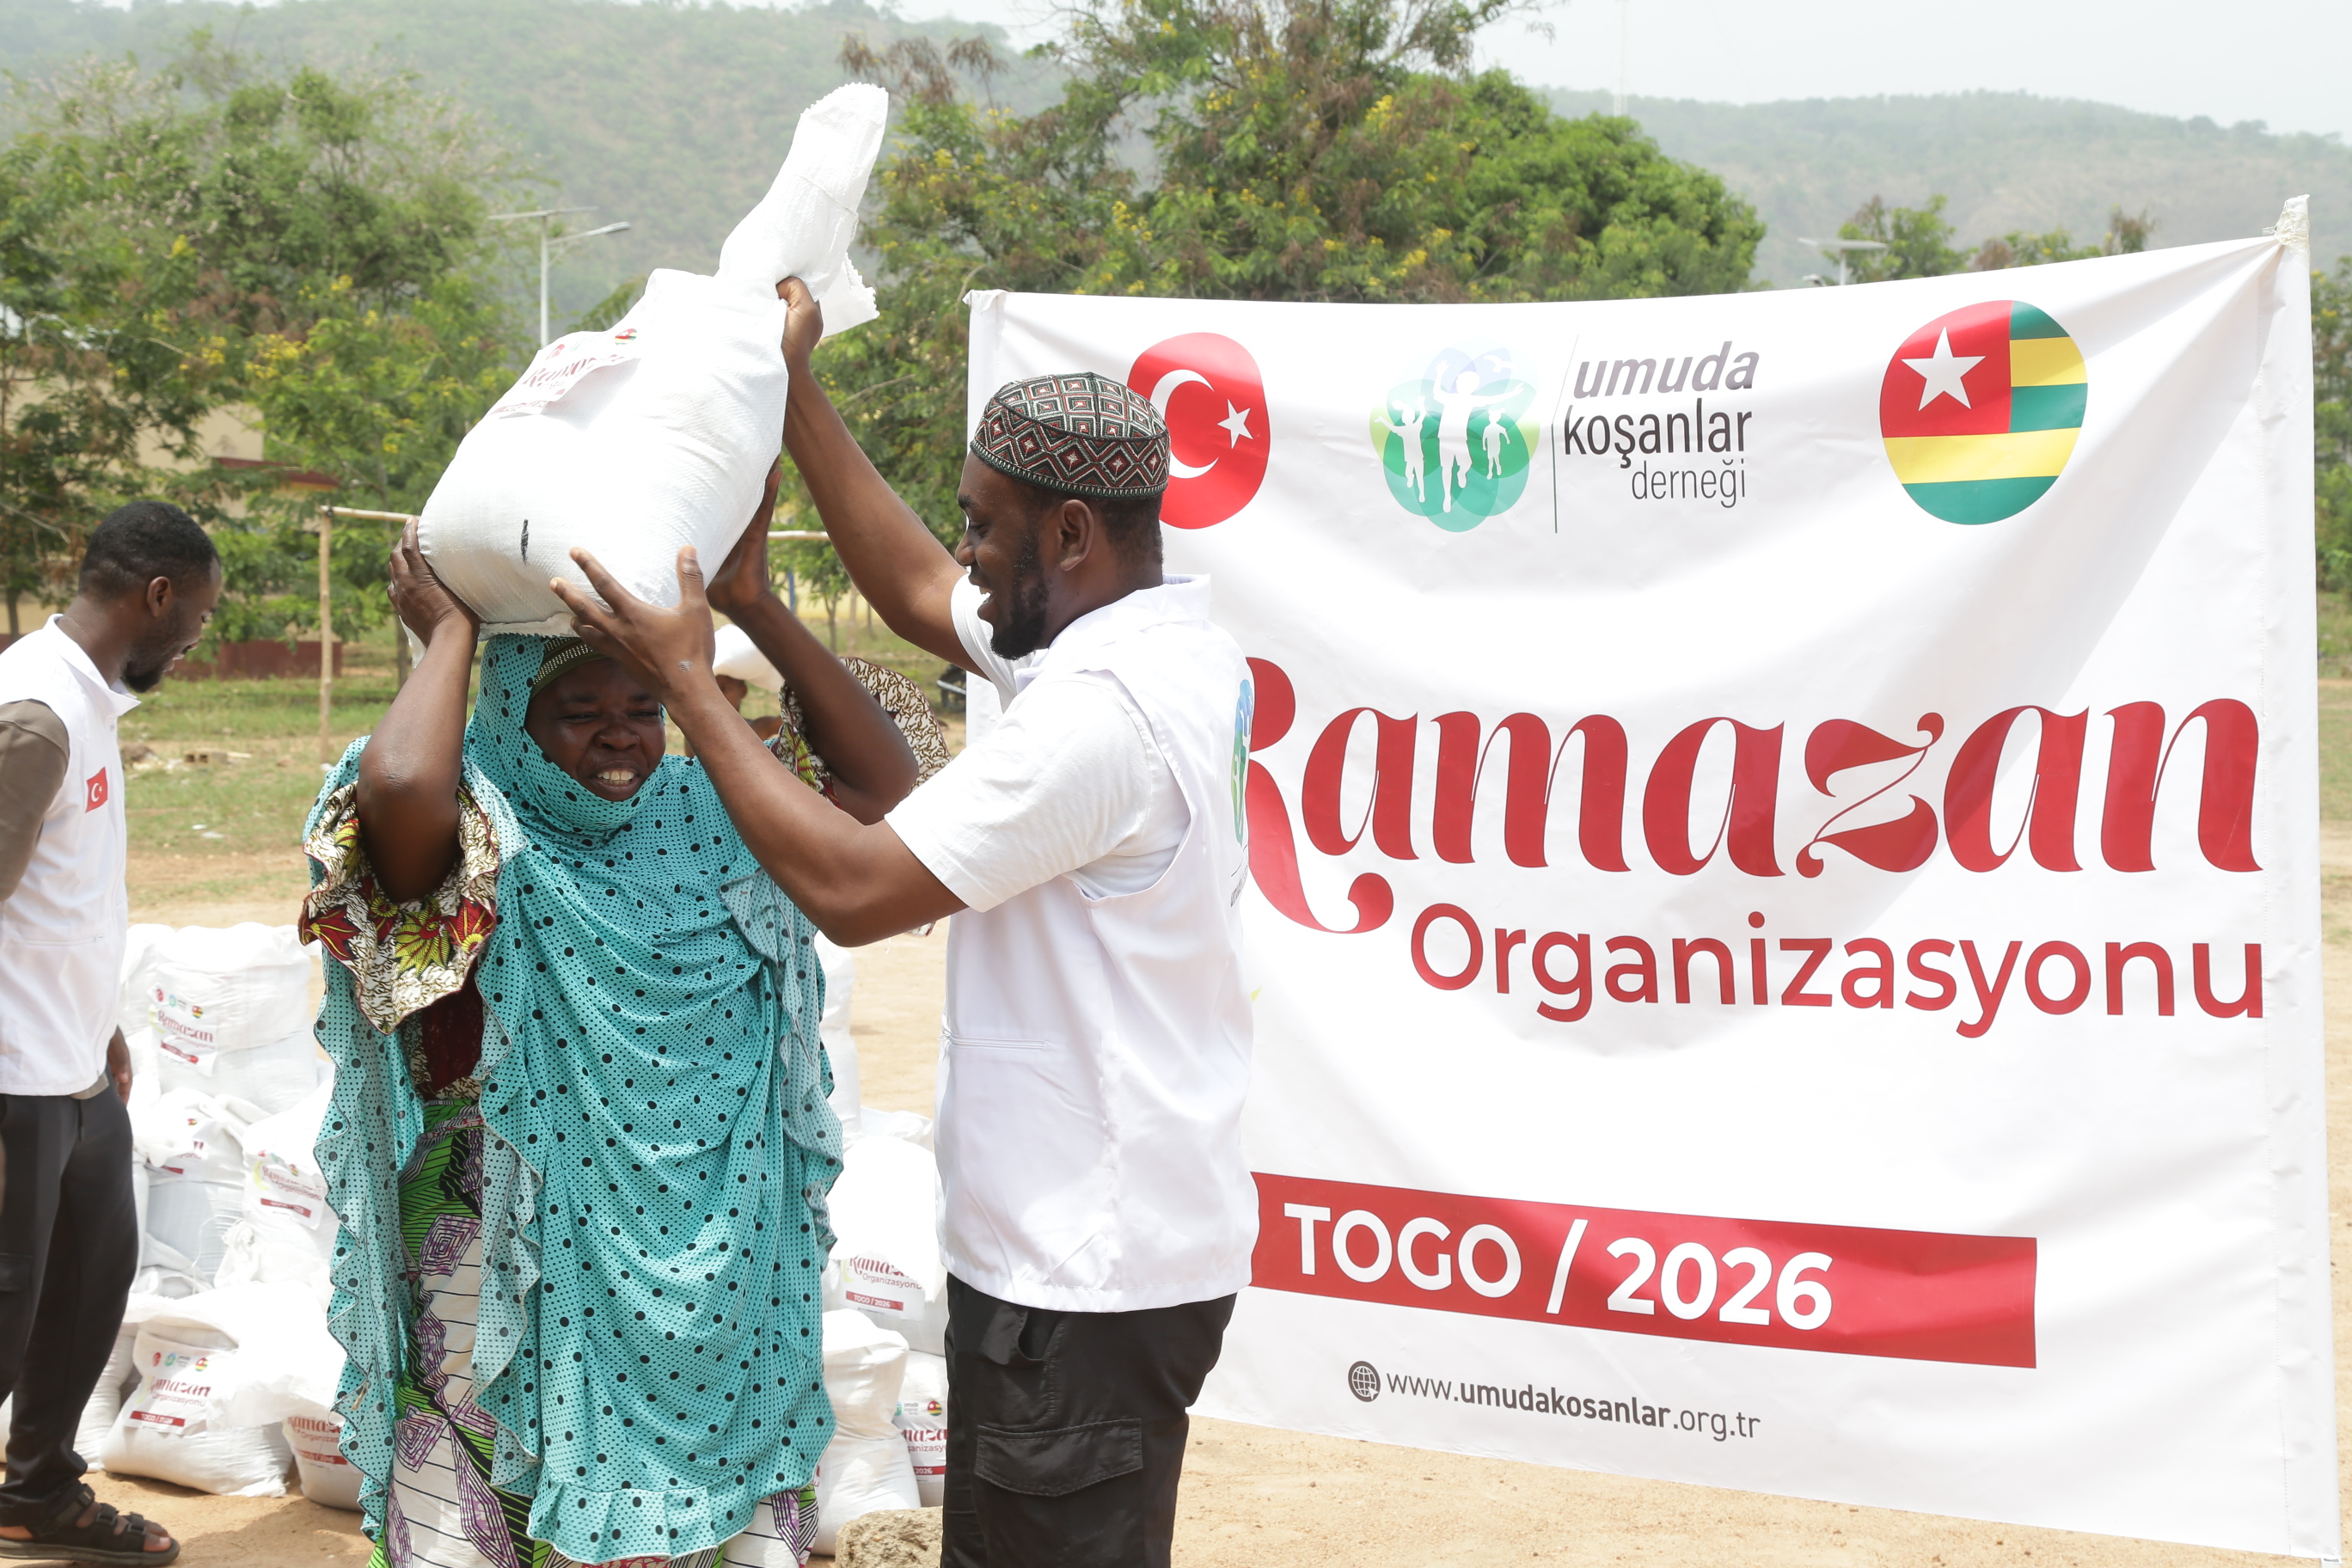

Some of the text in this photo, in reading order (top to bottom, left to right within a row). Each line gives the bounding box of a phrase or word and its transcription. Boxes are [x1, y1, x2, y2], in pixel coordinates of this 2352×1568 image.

[1572, 341, 1760, 400] umuda
[1563, 397, 1753, 469] koşanlar
[1631, 458, 1747, 509] derneği
[1244, 656, 2264, 934] Ramazan
[1411, 903, 2263, 1038] Organizasyonu
[854, 1294, 870, 1304] TOGO
[874, 1299, 891, 1308] 2026
[1283, 1202, 1833, 1331] TOGO / 2026
[1386, 1372, 1761, 1442] www.umudakosanlar.org.tr
